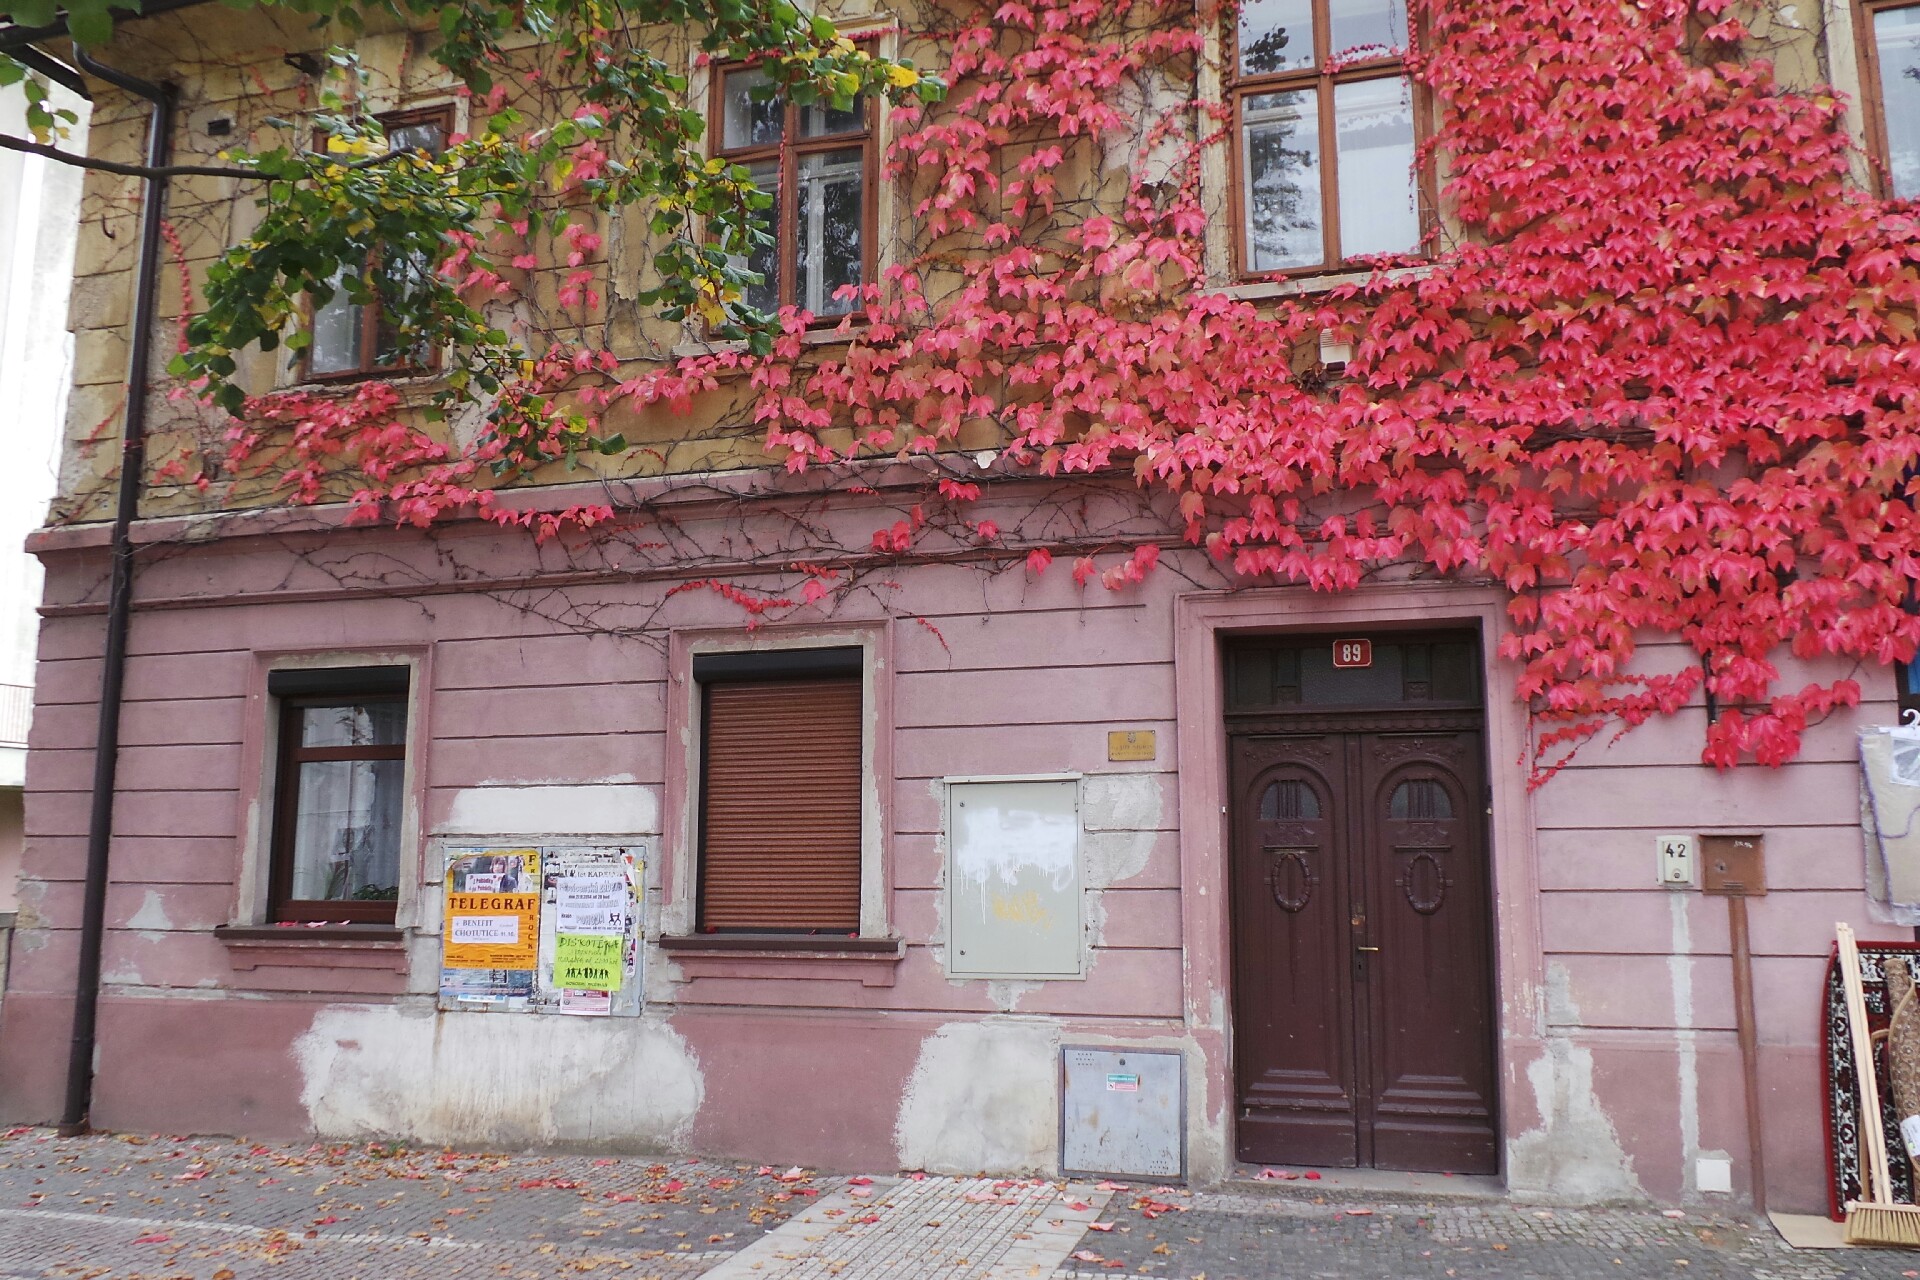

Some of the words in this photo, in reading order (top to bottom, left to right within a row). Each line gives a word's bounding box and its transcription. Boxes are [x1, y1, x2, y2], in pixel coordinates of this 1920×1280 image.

[1343, 644, 1361, 662] 89
[1665, 843, 1686, 858] 42
[449, 898, 536, 910] TELEGRAF
[462, 919, 494, 927] BENEFIT
[454, 929, 499, 937] CHOTUTICE
